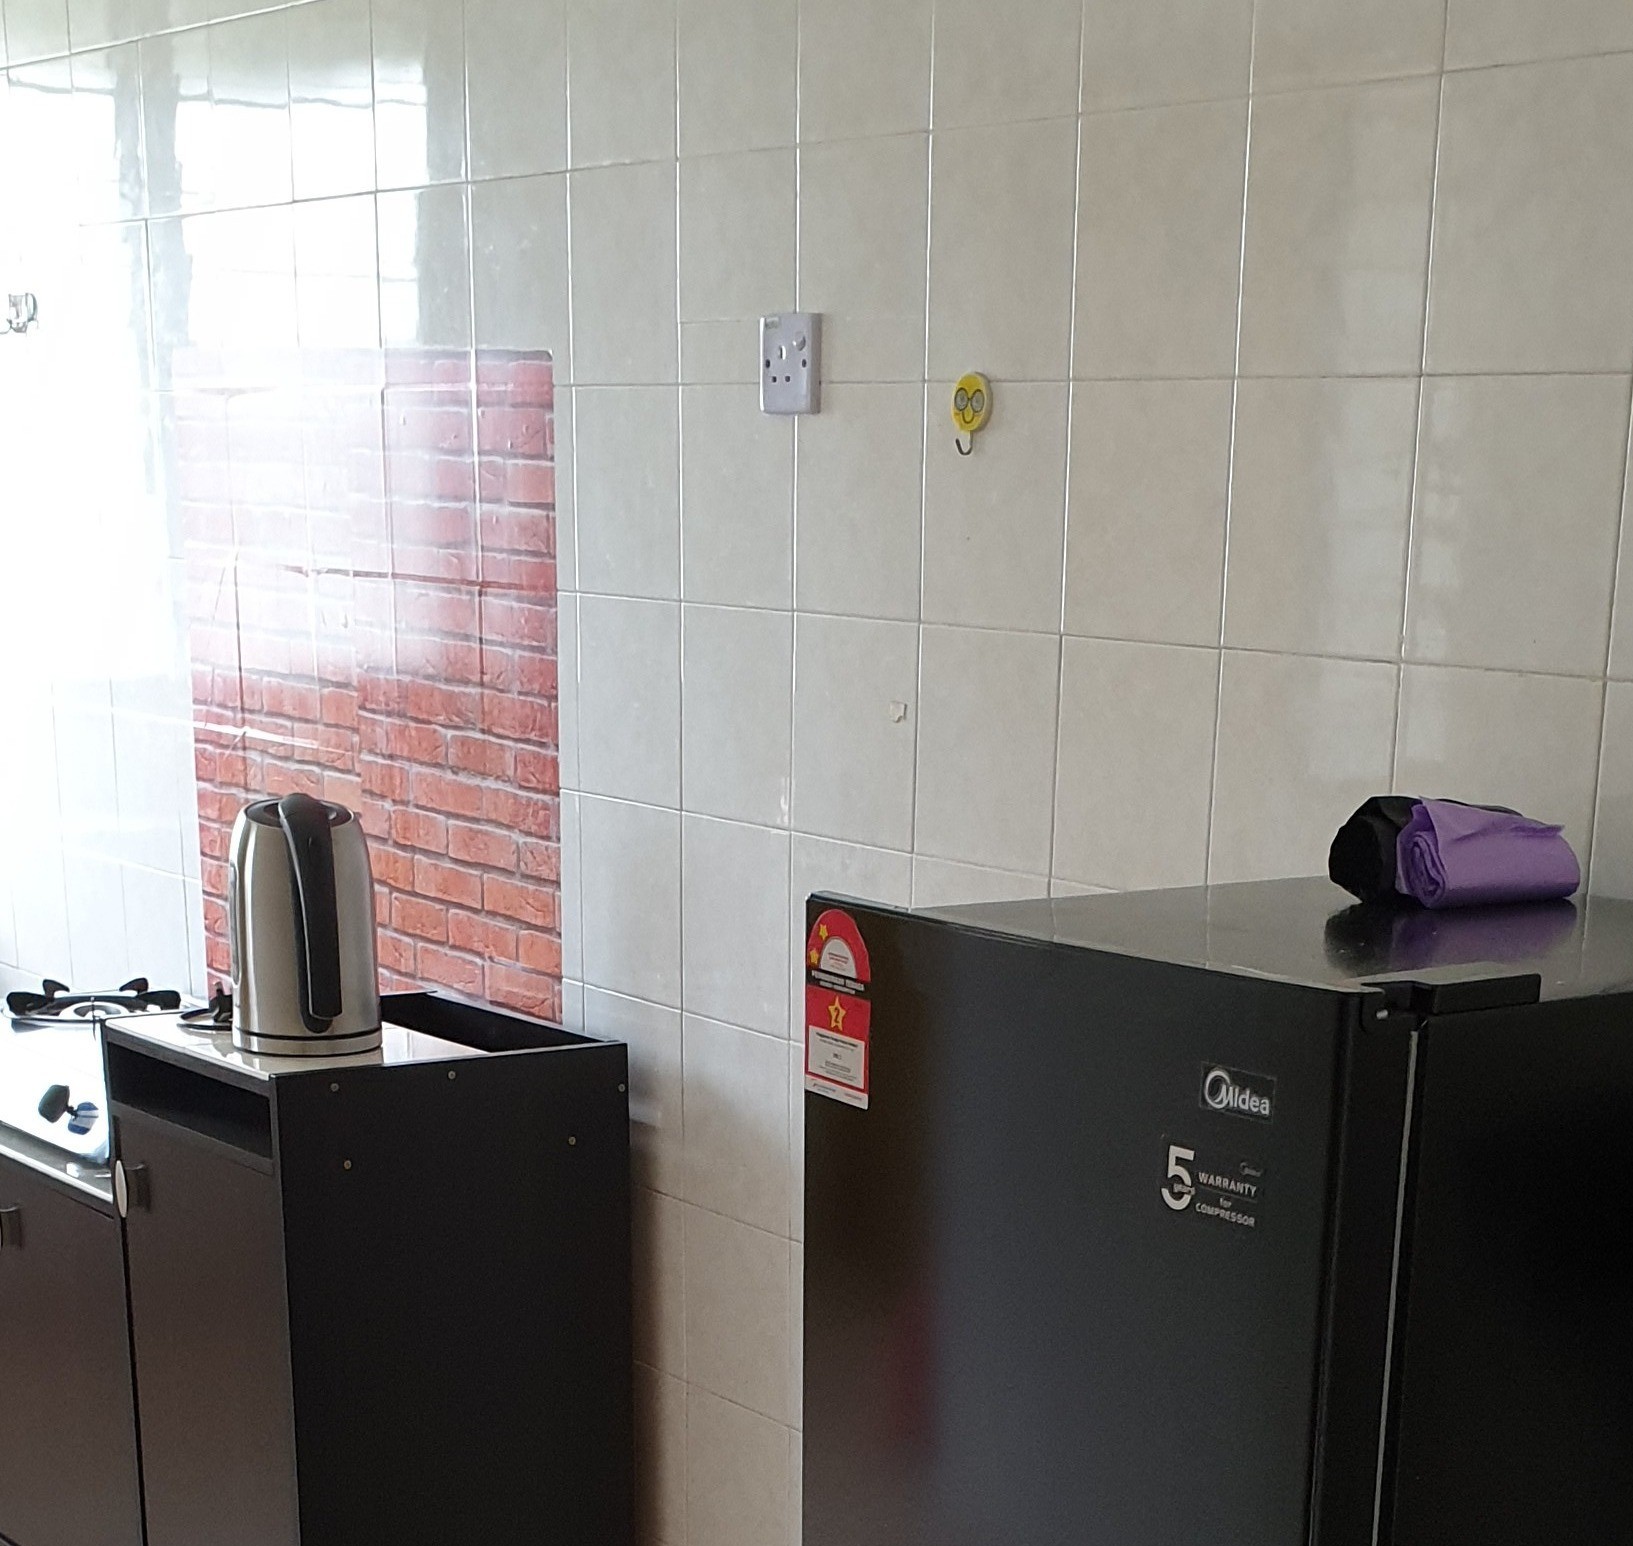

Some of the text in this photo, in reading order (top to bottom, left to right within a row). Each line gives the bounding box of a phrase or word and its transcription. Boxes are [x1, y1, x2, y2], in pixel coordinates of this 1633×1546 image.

[1204, 1069, 1270, 1116] Midea
[1161, 1145, 1195, 1210] 5
[1198, 1172, 1257, 1197] WARRANTY
[1195, 1202, 1255, 1228] COMPRESSOR
